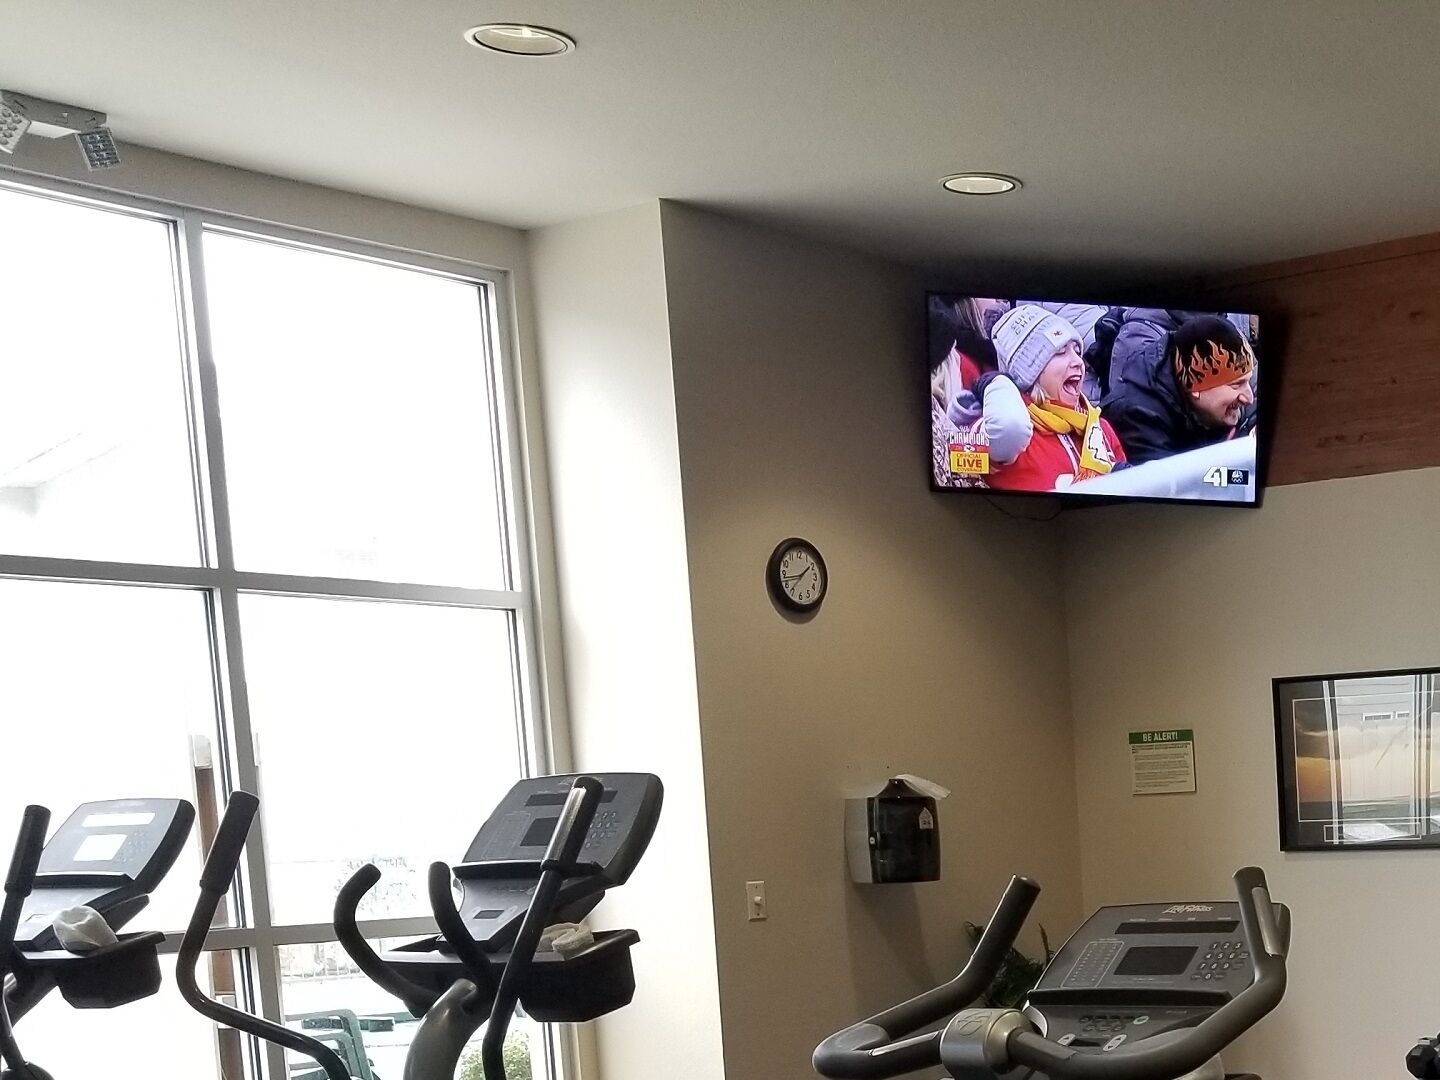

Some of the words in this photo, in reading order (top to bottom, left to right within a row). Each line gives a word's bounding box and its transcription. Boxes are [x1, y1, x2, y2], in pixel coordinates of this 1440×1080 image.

[957, 459, 982, 467] LIVE
[1203, 467, 1228, 487] 41
[1154, 731, 1178, 741] ALERT!
